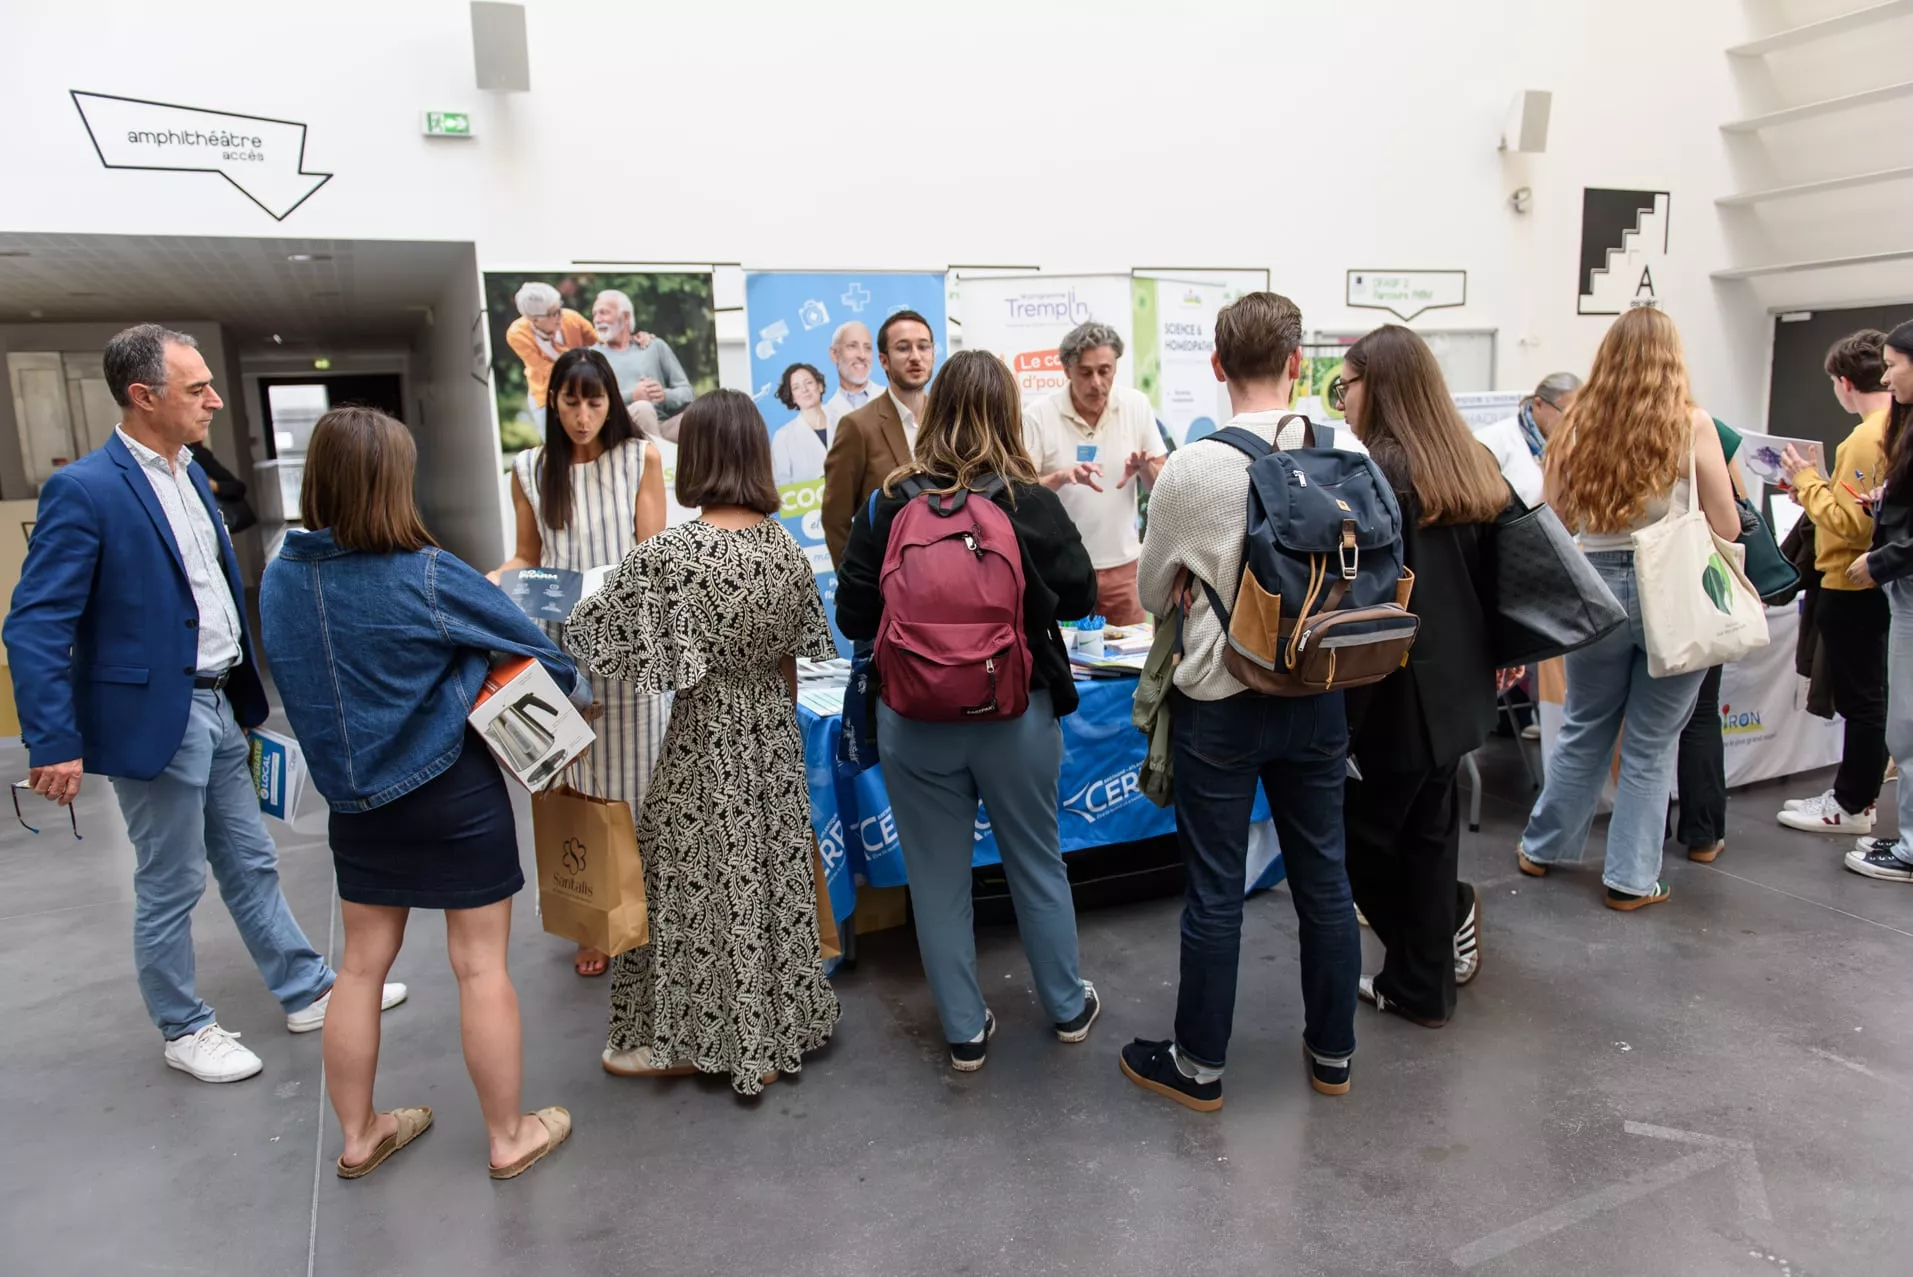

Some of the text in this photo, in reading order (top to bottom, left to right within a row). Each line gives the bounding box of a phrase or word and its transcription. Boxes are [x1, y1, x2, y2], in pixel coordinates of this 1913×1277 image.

[127, 129, 262, 148] amphithéâtre
[222, 149, 264, 161] accès
[1636, 264, 1654, 297] A
[1164, 323, 1195, 335] SCIENCE
[1021, 355, 1040, 369] Le
[262, 754, 271, 788] LOCAL
[1086, 767, 1142, 813] CER
[819, 819, 845, 878] RP
[553, 872, 594, 897] Santalis
